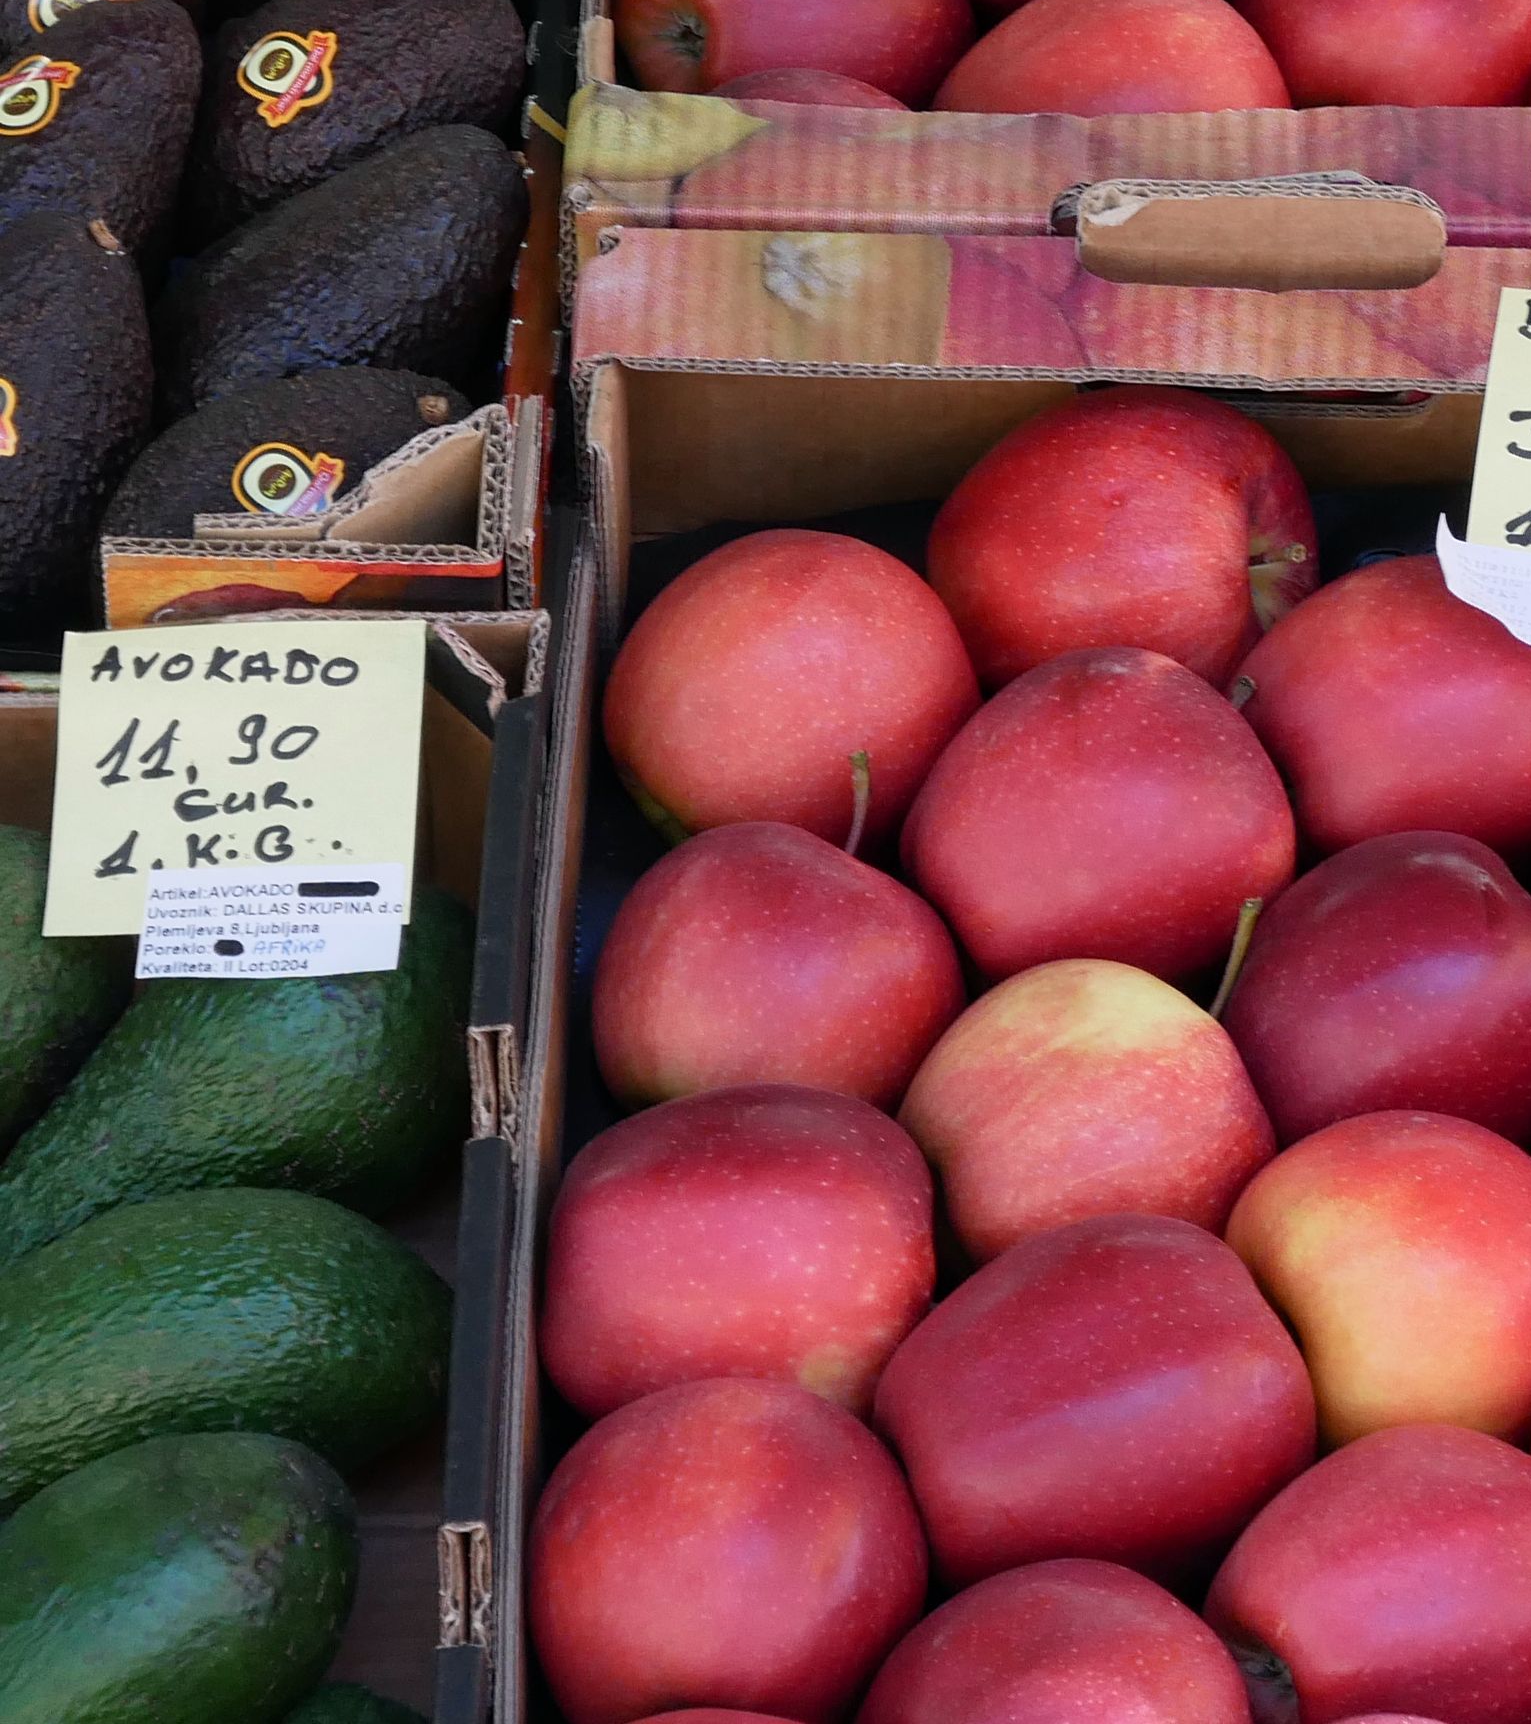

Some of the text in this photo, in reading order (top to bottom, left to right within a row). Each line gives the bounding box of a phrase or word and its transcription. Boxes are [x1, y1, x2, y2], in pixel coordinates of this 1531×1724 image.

[91, 644, 360, 688] AVOKADO
[147, 906, 217, 921] Uvoznik:
[223, 902, 290, 917] DALLAS
[296, 901, 373, 915] SKUPINA
[144, 924, 225, 939] Plemljeva
[143, 943, 212, 957] Poreklo:
[140, 960, 217, 974] Kvaliteta:
